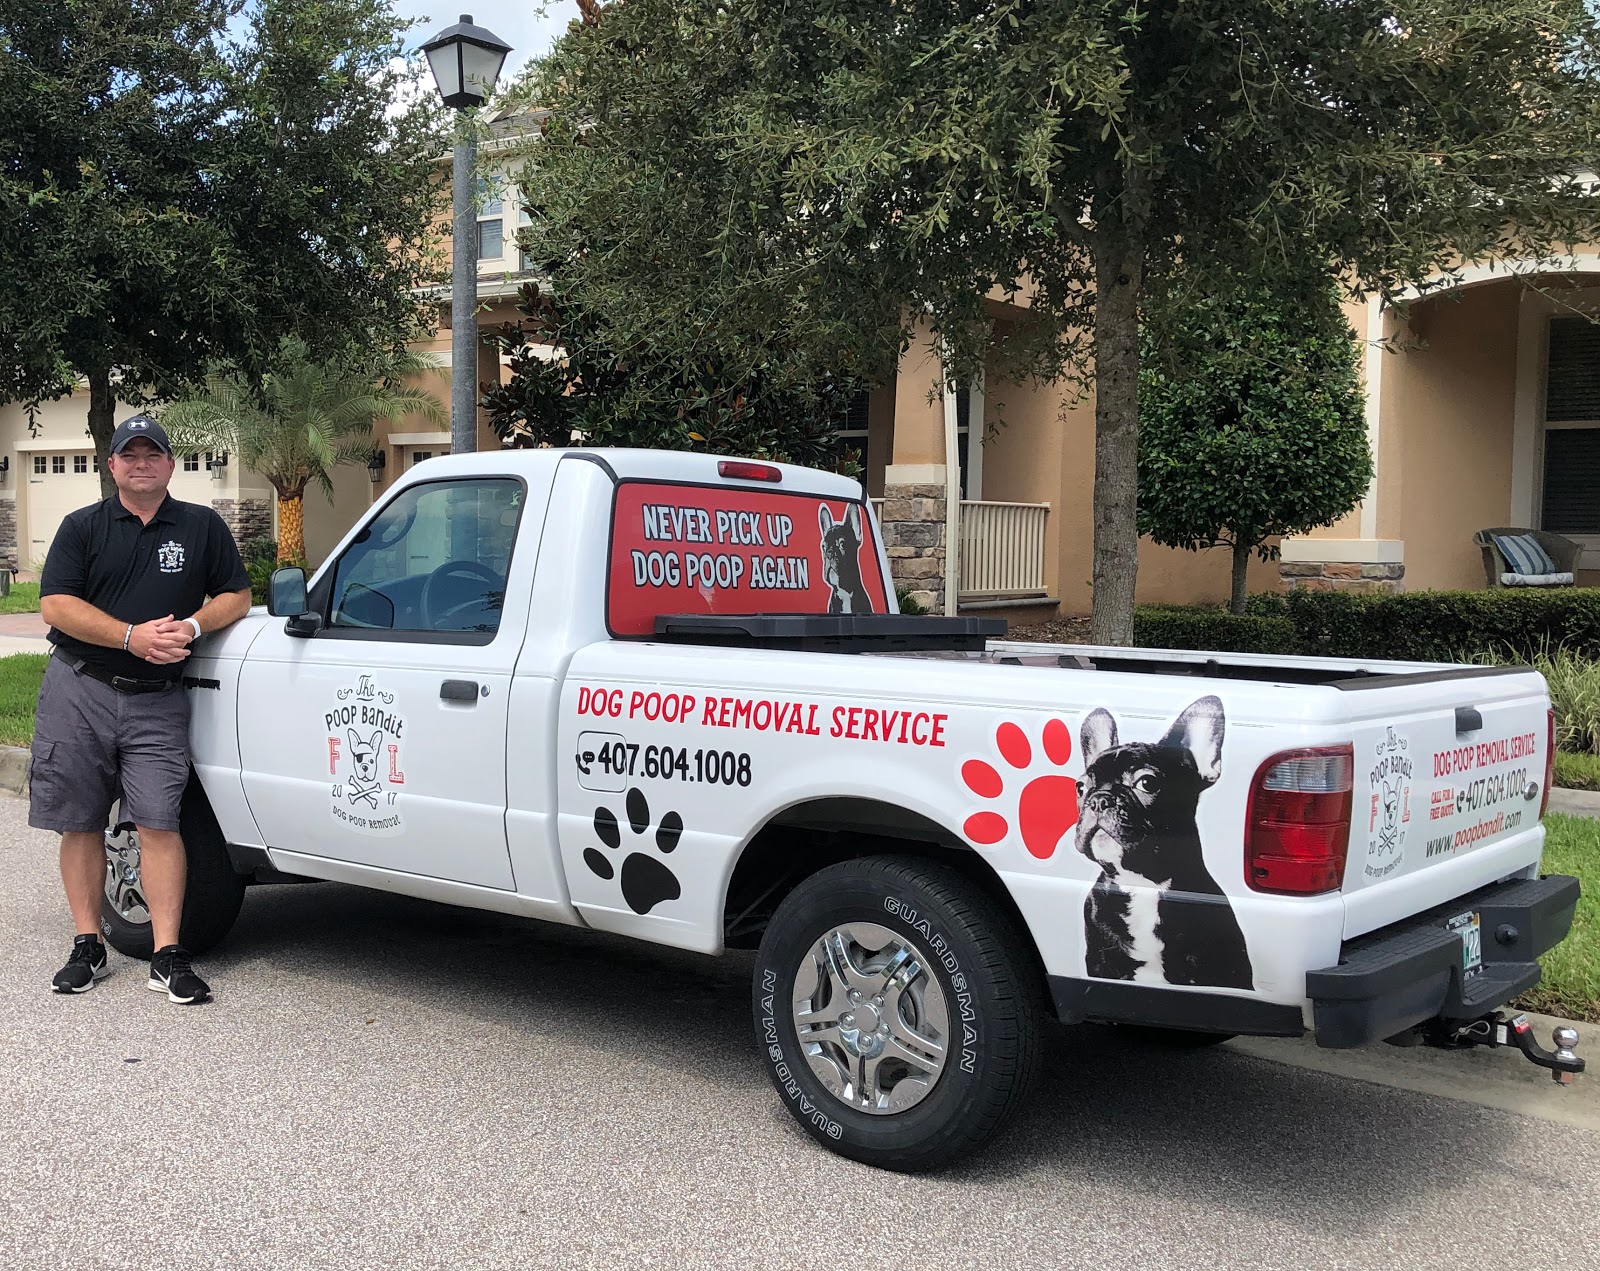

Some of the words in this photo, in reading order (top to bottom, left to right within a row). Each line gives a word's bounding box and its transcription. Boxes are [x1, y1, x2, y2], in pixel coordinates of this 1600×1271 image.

[642, 504, 713, 543] NEVER
[715, 510, 763, 546] PICK
[766, 513, 794, 547] UP
[631, 550, 680, 587] DOG
[685, 552, 744, 589] POOP
[750, 555, 809, 590] AGAIN
[356, 674, 375, 697] The
[325, 705, 357, 732] POOP
[362, 705, 403, 739] Bandit
[577, 687, 623, 718] DOG
[629, 691, 696, 724] POOP
[702, 696, 820, 736] REMOVAL
[830, 706, 948, 747] SERVICE
[328, 737, 341, 775] F
[388, 745, 404, 784] L
[598, 741, 751, 787] 407.604.1008
[1370, 758, 1388, 790] POOP
[1433, 751, 1451, 778] DOG
[1453, 746, 1474, 773] POOP
[1476, 739, 1509, 768] REMOVAL
[1510, 733, 1536, 759] SERVICE
[332, 784, 342, 798] 20
[387, 792, 397, 805] 17
[1431, 791, 1441, 804] CALL
[1466, 768, 1527, 812] 407.604.1008
[333, 805, 347, 820] DOG
[349, 815, 366, 828] POOP
[1426, 810, 1522, 859] www.poopbandit.com
[1430, 807, 1440, 820] FREE
[884, 896, 977, 1074] GUARDSMAN
[762, 969, 843, 1140] GUARDSMAN
